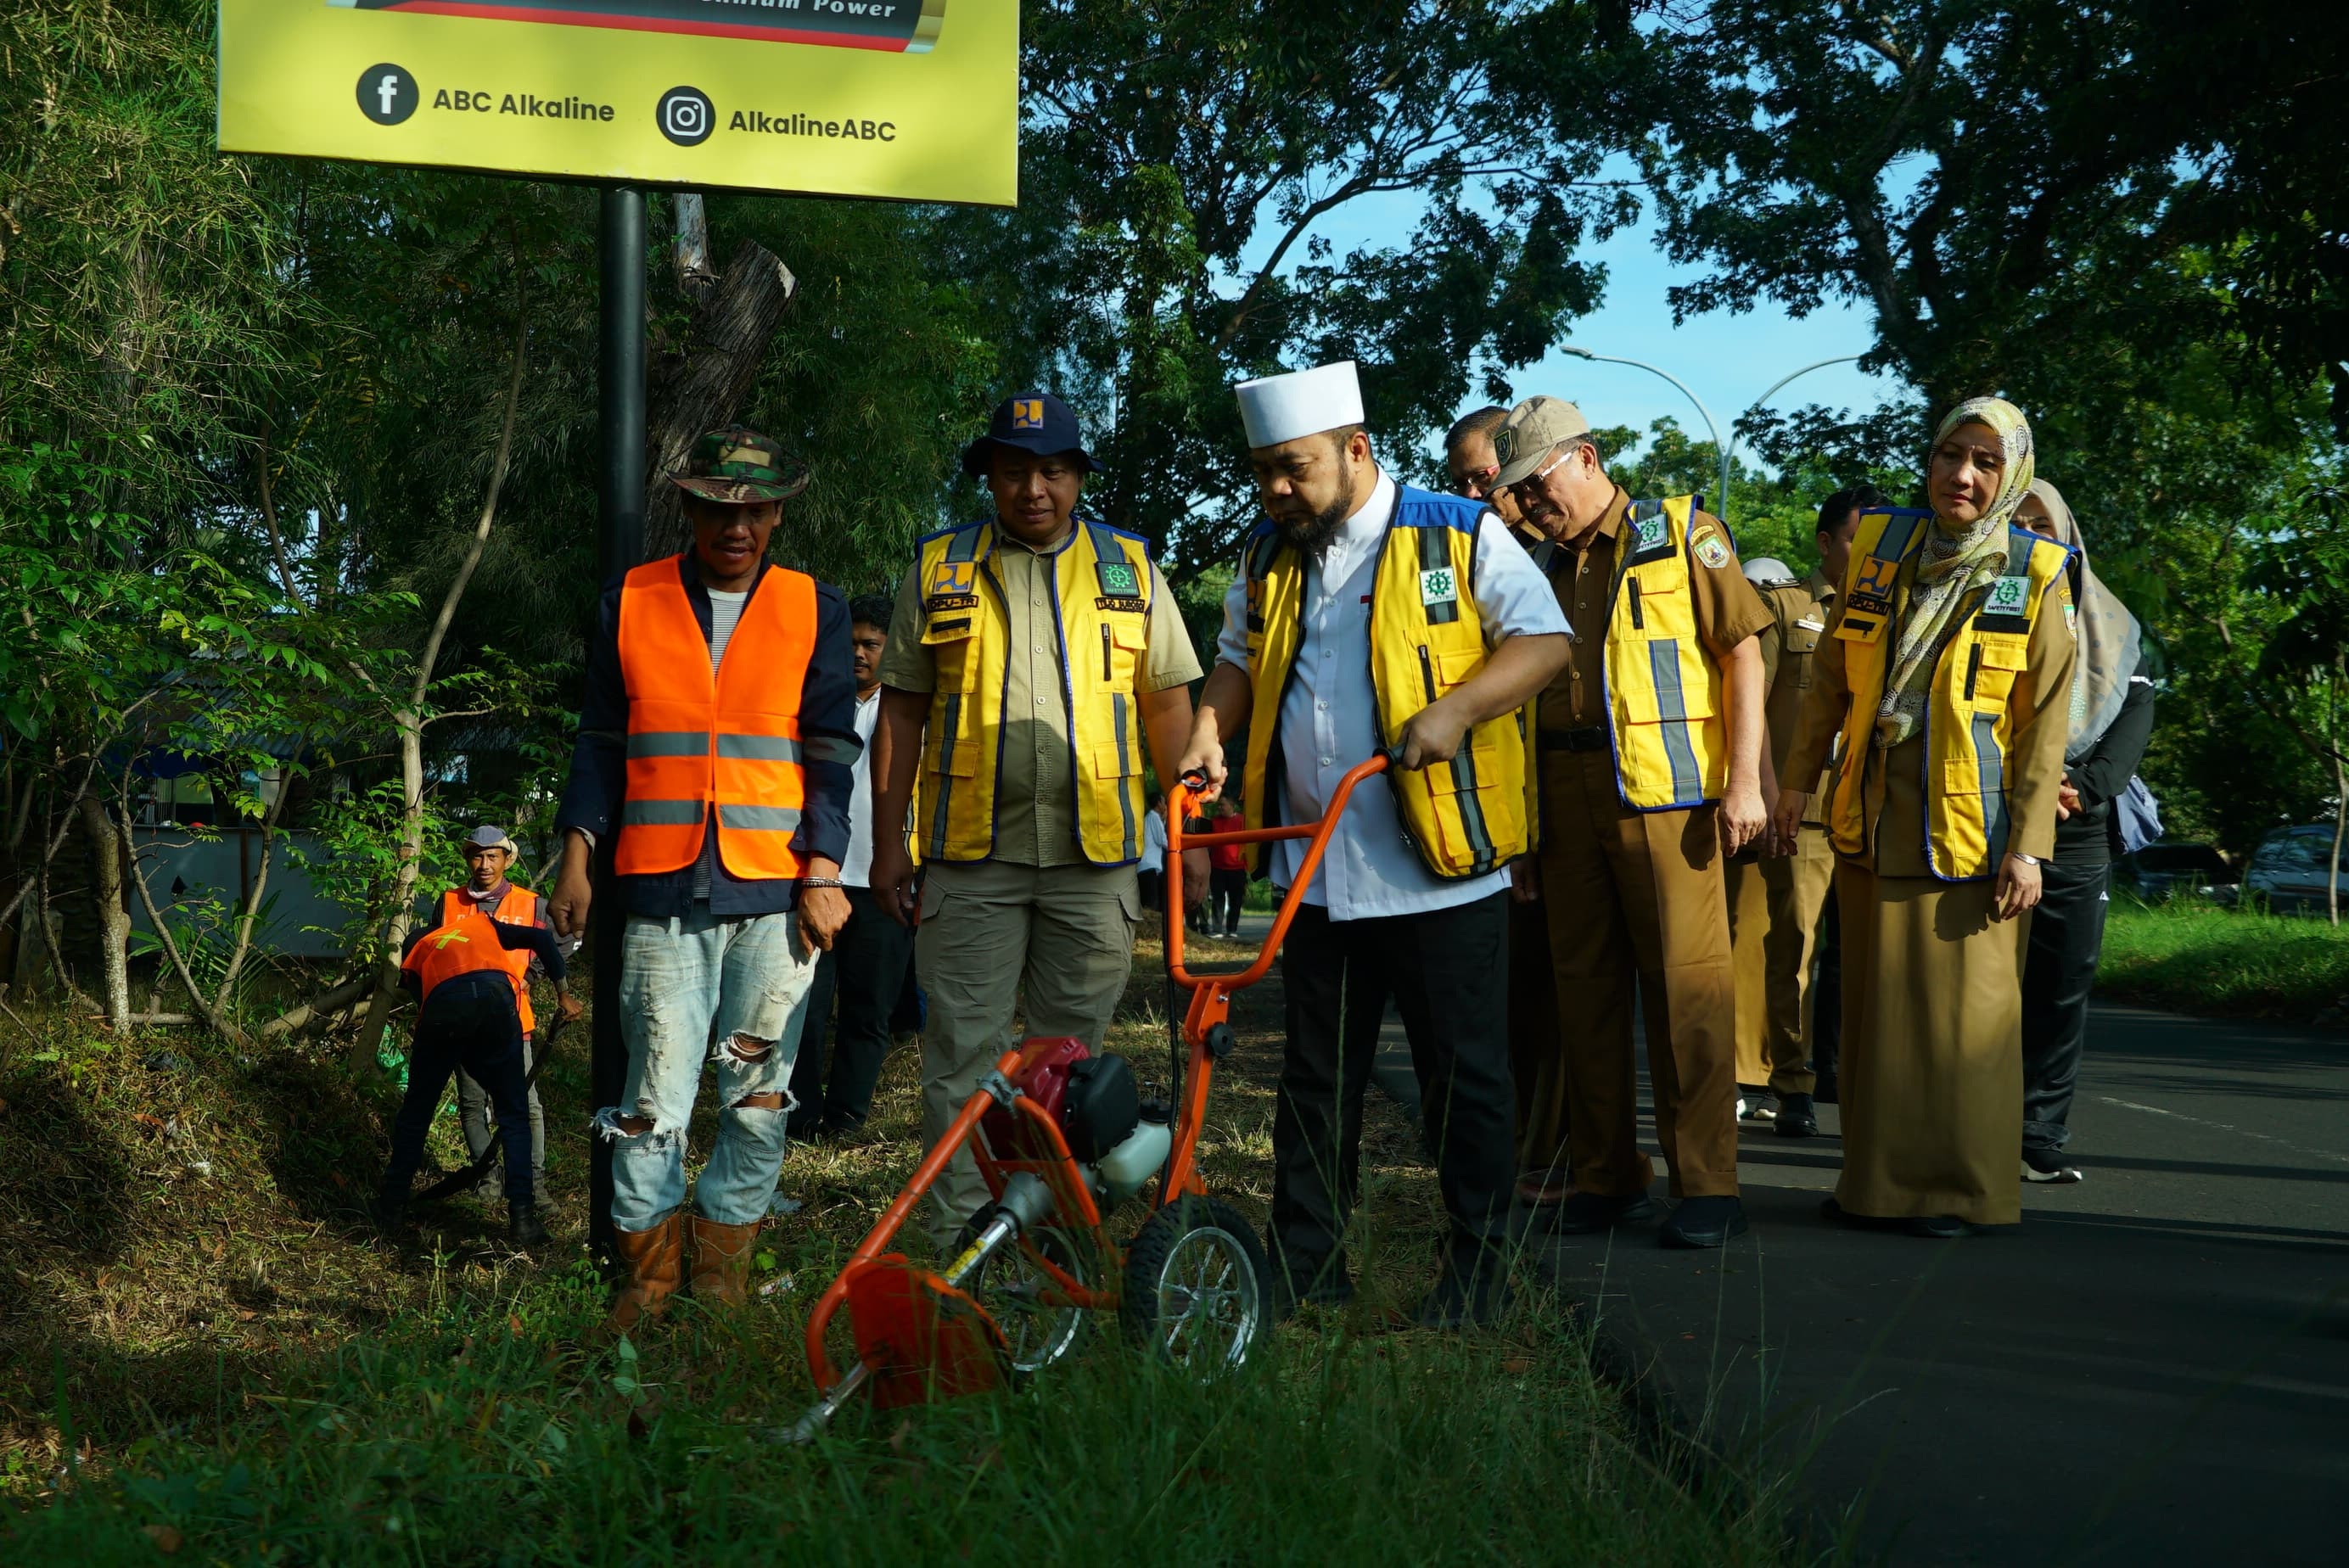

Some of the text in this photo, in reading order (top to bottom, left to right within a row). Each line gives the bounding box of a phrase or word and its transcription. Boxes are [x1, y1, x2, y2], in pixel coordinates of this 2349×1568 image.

[813, 0, 896, 17] Power
[433, 88, 615, 121] ABC Alkaline
[729, 110, 896, 142] AlkalineABC
